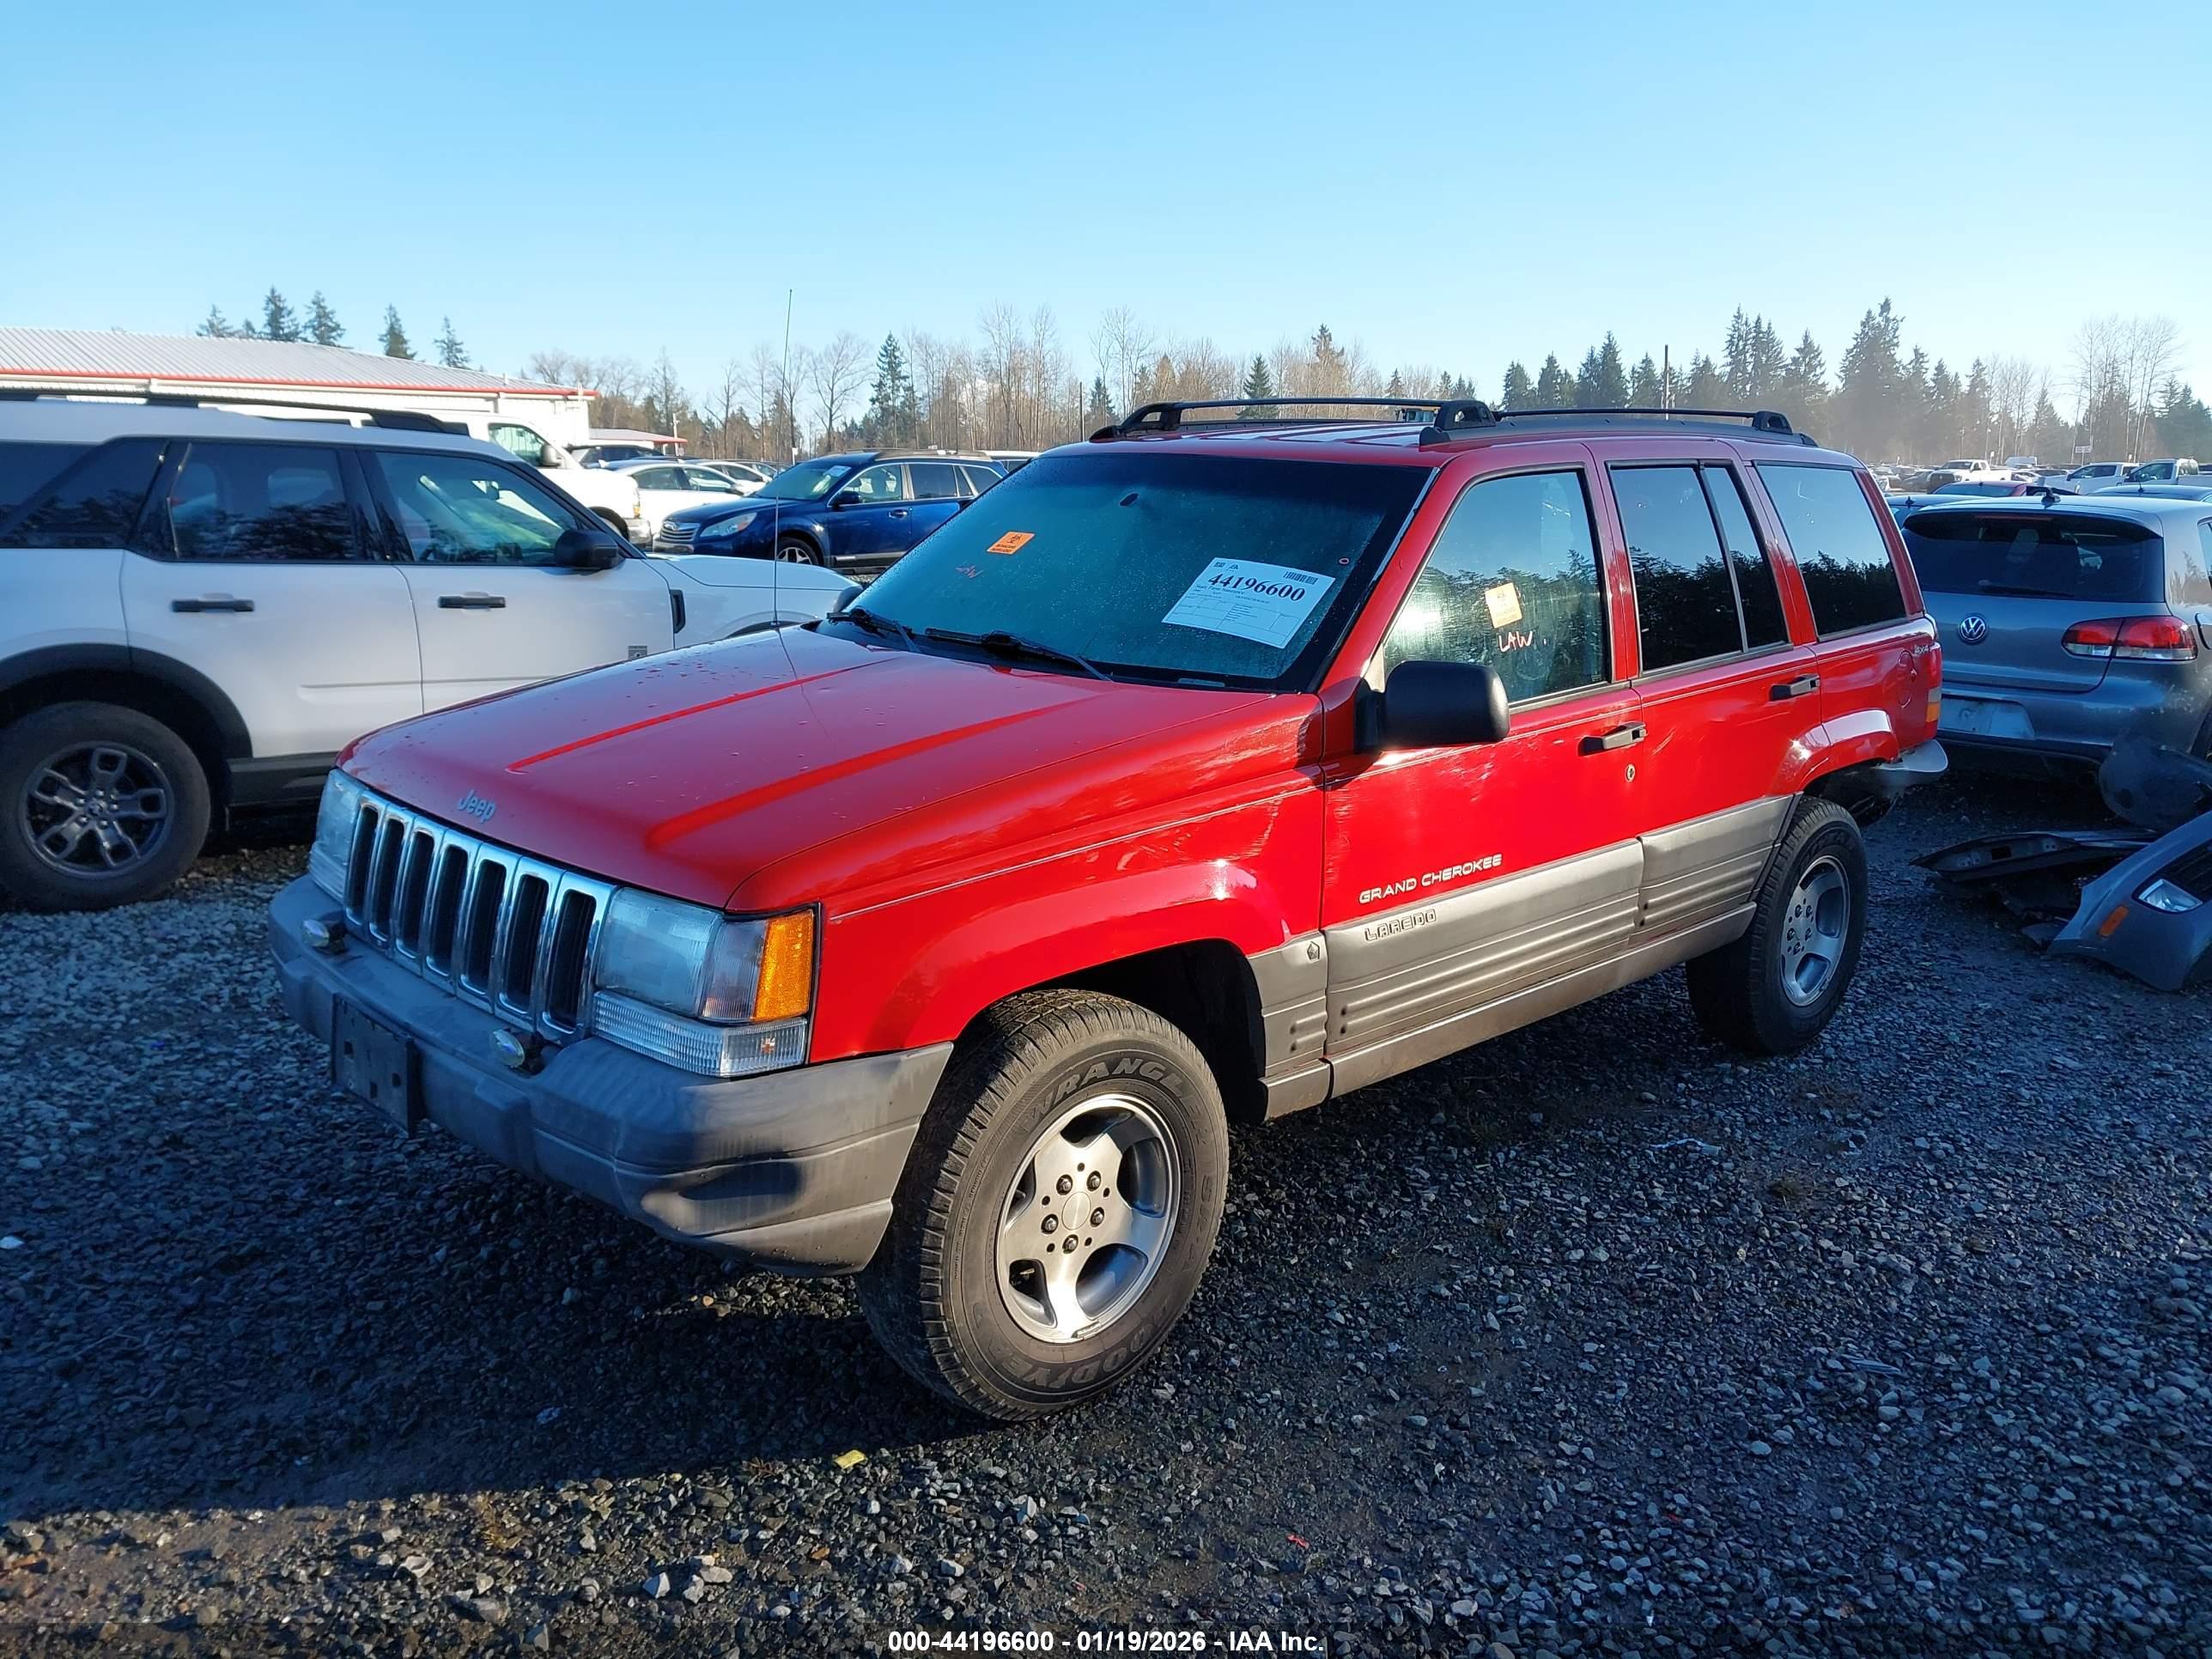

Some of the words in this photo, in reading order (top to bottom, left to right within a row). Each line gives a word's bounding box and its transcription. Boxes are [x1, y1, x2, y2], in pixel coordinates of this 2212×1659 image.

[1208, 573, 1306, 601] 44196600
[1498, 631, 1533, 653] LAW
[457, 789, 495, 824] Jeep
[1359, 878, 1417, 904] GRAND
[1421, 854, 1503, 887] CHEROKEE
[1364, 908, 1437, 942] LAREDO
[1026, 1057, 1212, 1146] WRANGLER
